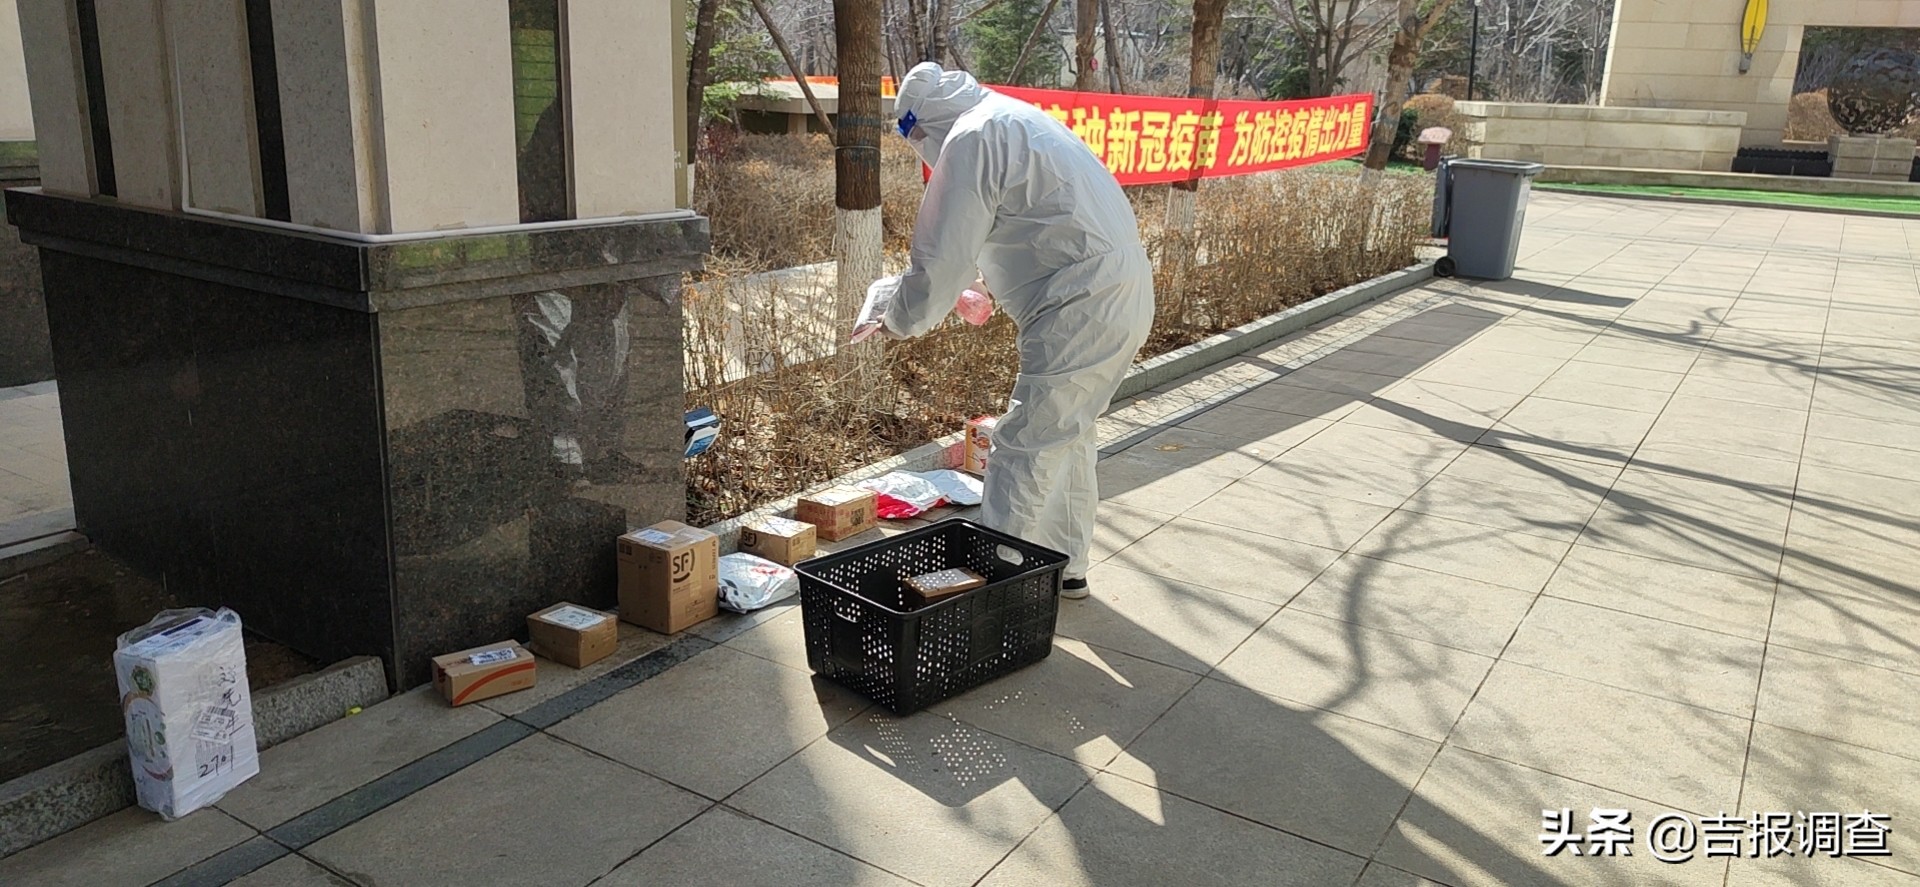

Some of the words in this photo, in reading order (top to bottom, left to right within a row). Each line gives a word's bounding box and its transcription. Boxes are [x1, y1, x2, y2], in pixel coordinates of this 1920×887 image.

[1034, 103, 1224, 174] 种新冠疫苗
[1228, 102, 1367, 167] 为防控疫情出力量
[672, 551, 691, 576] SF
